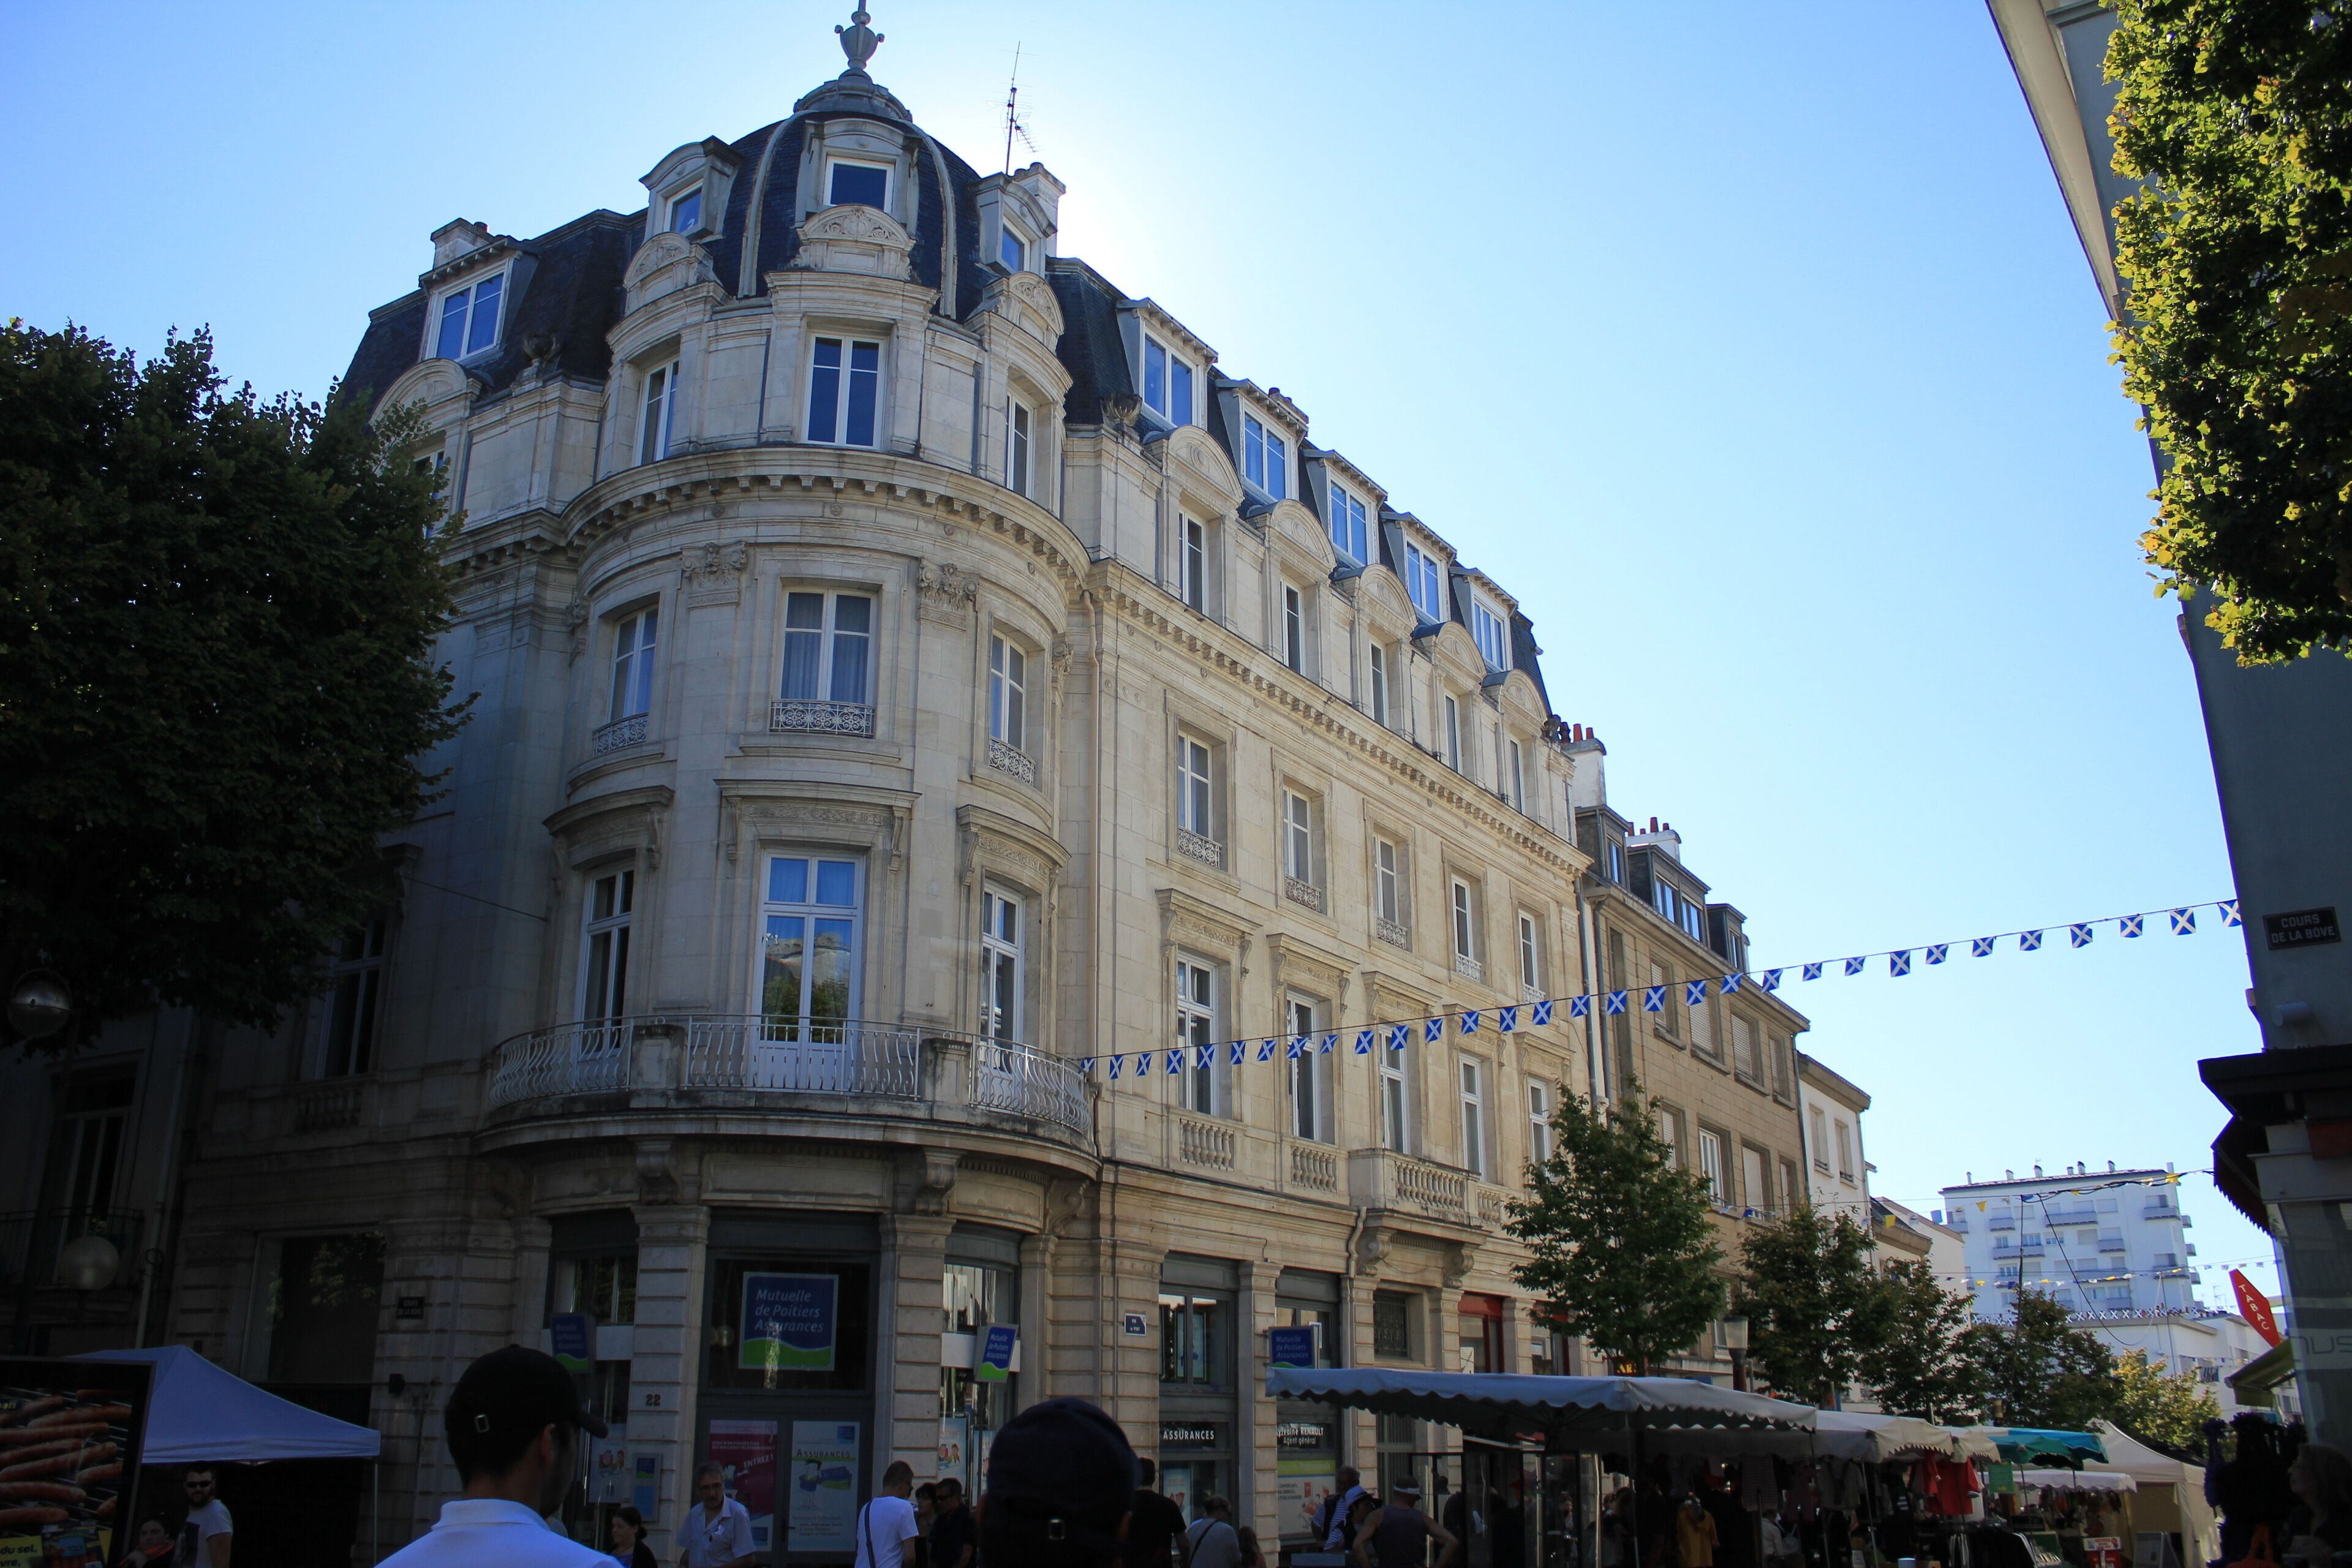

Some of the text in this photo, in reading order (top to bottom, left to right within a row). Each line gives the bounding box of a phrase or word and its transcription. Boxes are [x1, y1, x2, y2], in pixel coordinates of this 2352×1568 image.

[2280, 914, 2320, 928] COURS
[2271, 932, 2286, 943] DE
[2288, 930, 2303, 941] LA
[756, 1288, 812, 1303] Mutuelle
[755, 1303, 821, 1317] de Poitiers
[2239, 1284, 2269, 1330] TABAC
[754, 1319, 824, 1333] Assurances
[646, 1393, 661, 1406] 22
[1163, 1430, 1215, 1440] ASSURANCES
[1300, 1426, 1323, 1436] RENAULT
[1283, 1437, 1316, 1446] Agent général
[744, 1455, 770, 1468] ENTREZ
[1, 1544, 37, 1555] du sel,
